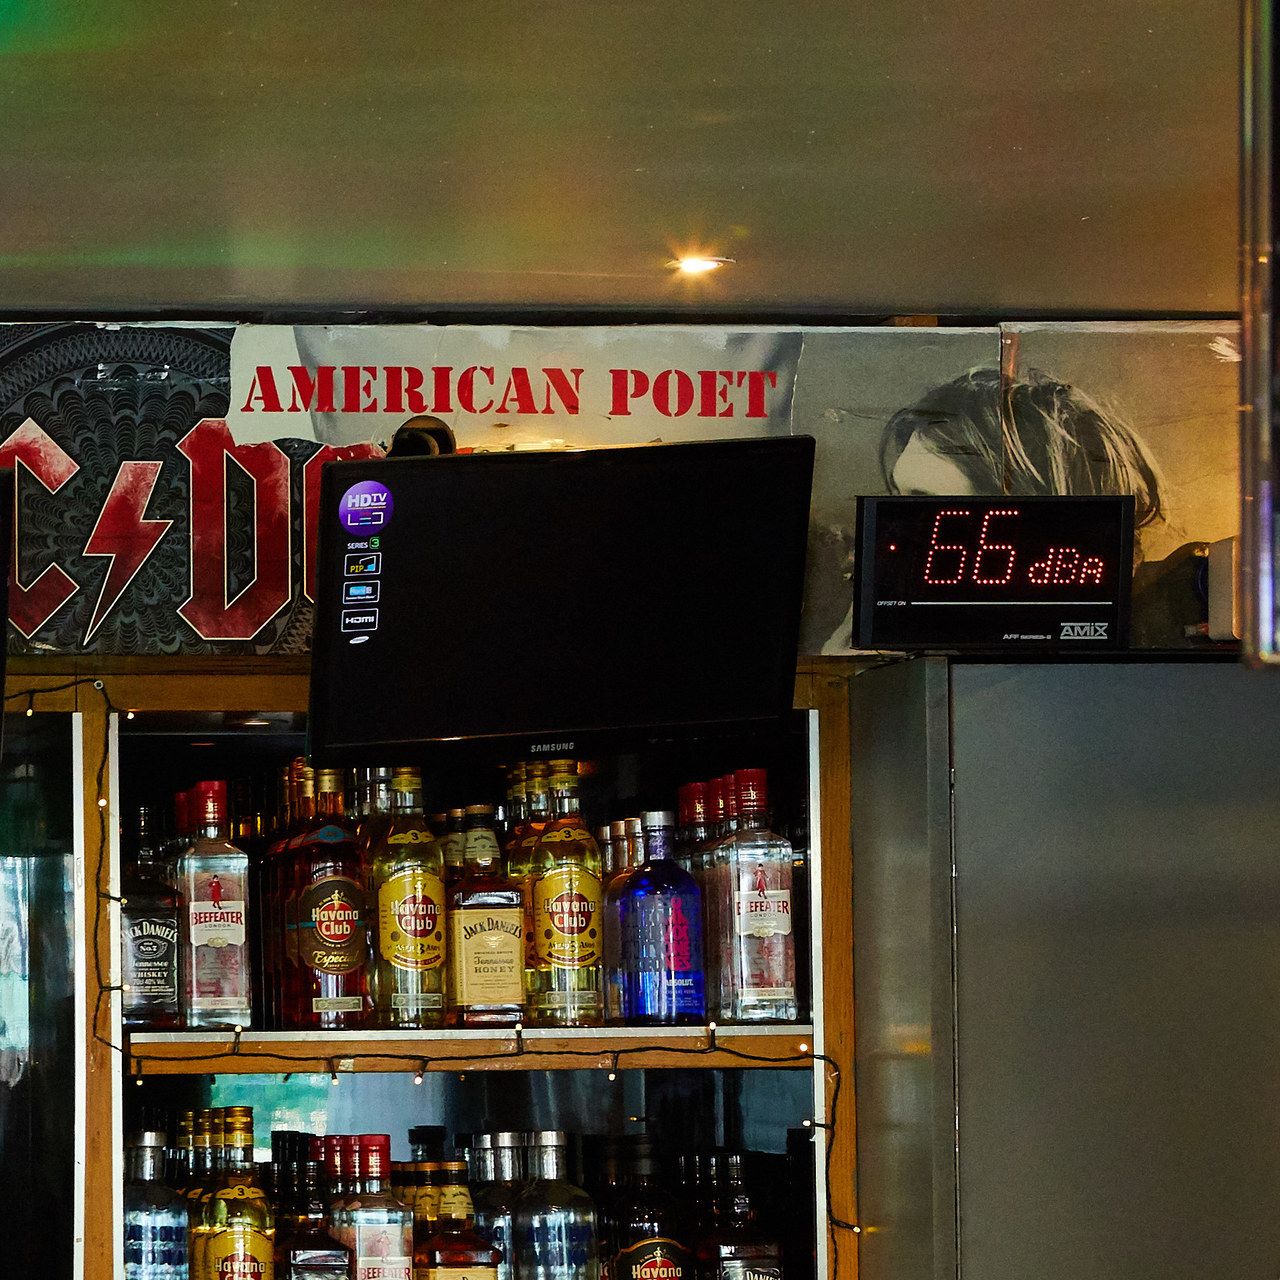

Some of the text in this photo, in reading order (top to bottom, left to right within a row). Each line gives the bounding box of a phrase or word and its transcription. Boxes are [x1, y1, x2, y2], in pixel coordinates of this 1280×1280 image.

[241, 365, 777, 419] AMERICAN POET
[347, 541, 369, 550] SERIES
[923, 510, 1020, 585] 66
[349, 565, 365, 573] PIP
[345, 615, 375, 624] HDMI
[530, 742, 575, 753] SAMSUNG
[564, 830, 573, 839] 3
[390, 900, 441, 915] Havana
[543, 898, 595, 913] Havana
[193, 911, 244, 925] BEEFEATER
[311, 907, 359, 921] Havana
[554, 913, 586, 928] Club
[321, 921, 351, 935] Club
[401, 916, 433, 931] Club
[463, 920, 487, 940] JACK
[236, 1188, 245, 1196] 3
[215, 1257, 266, 1273] Havana
[632, 1264, 682, 1279] Havana
